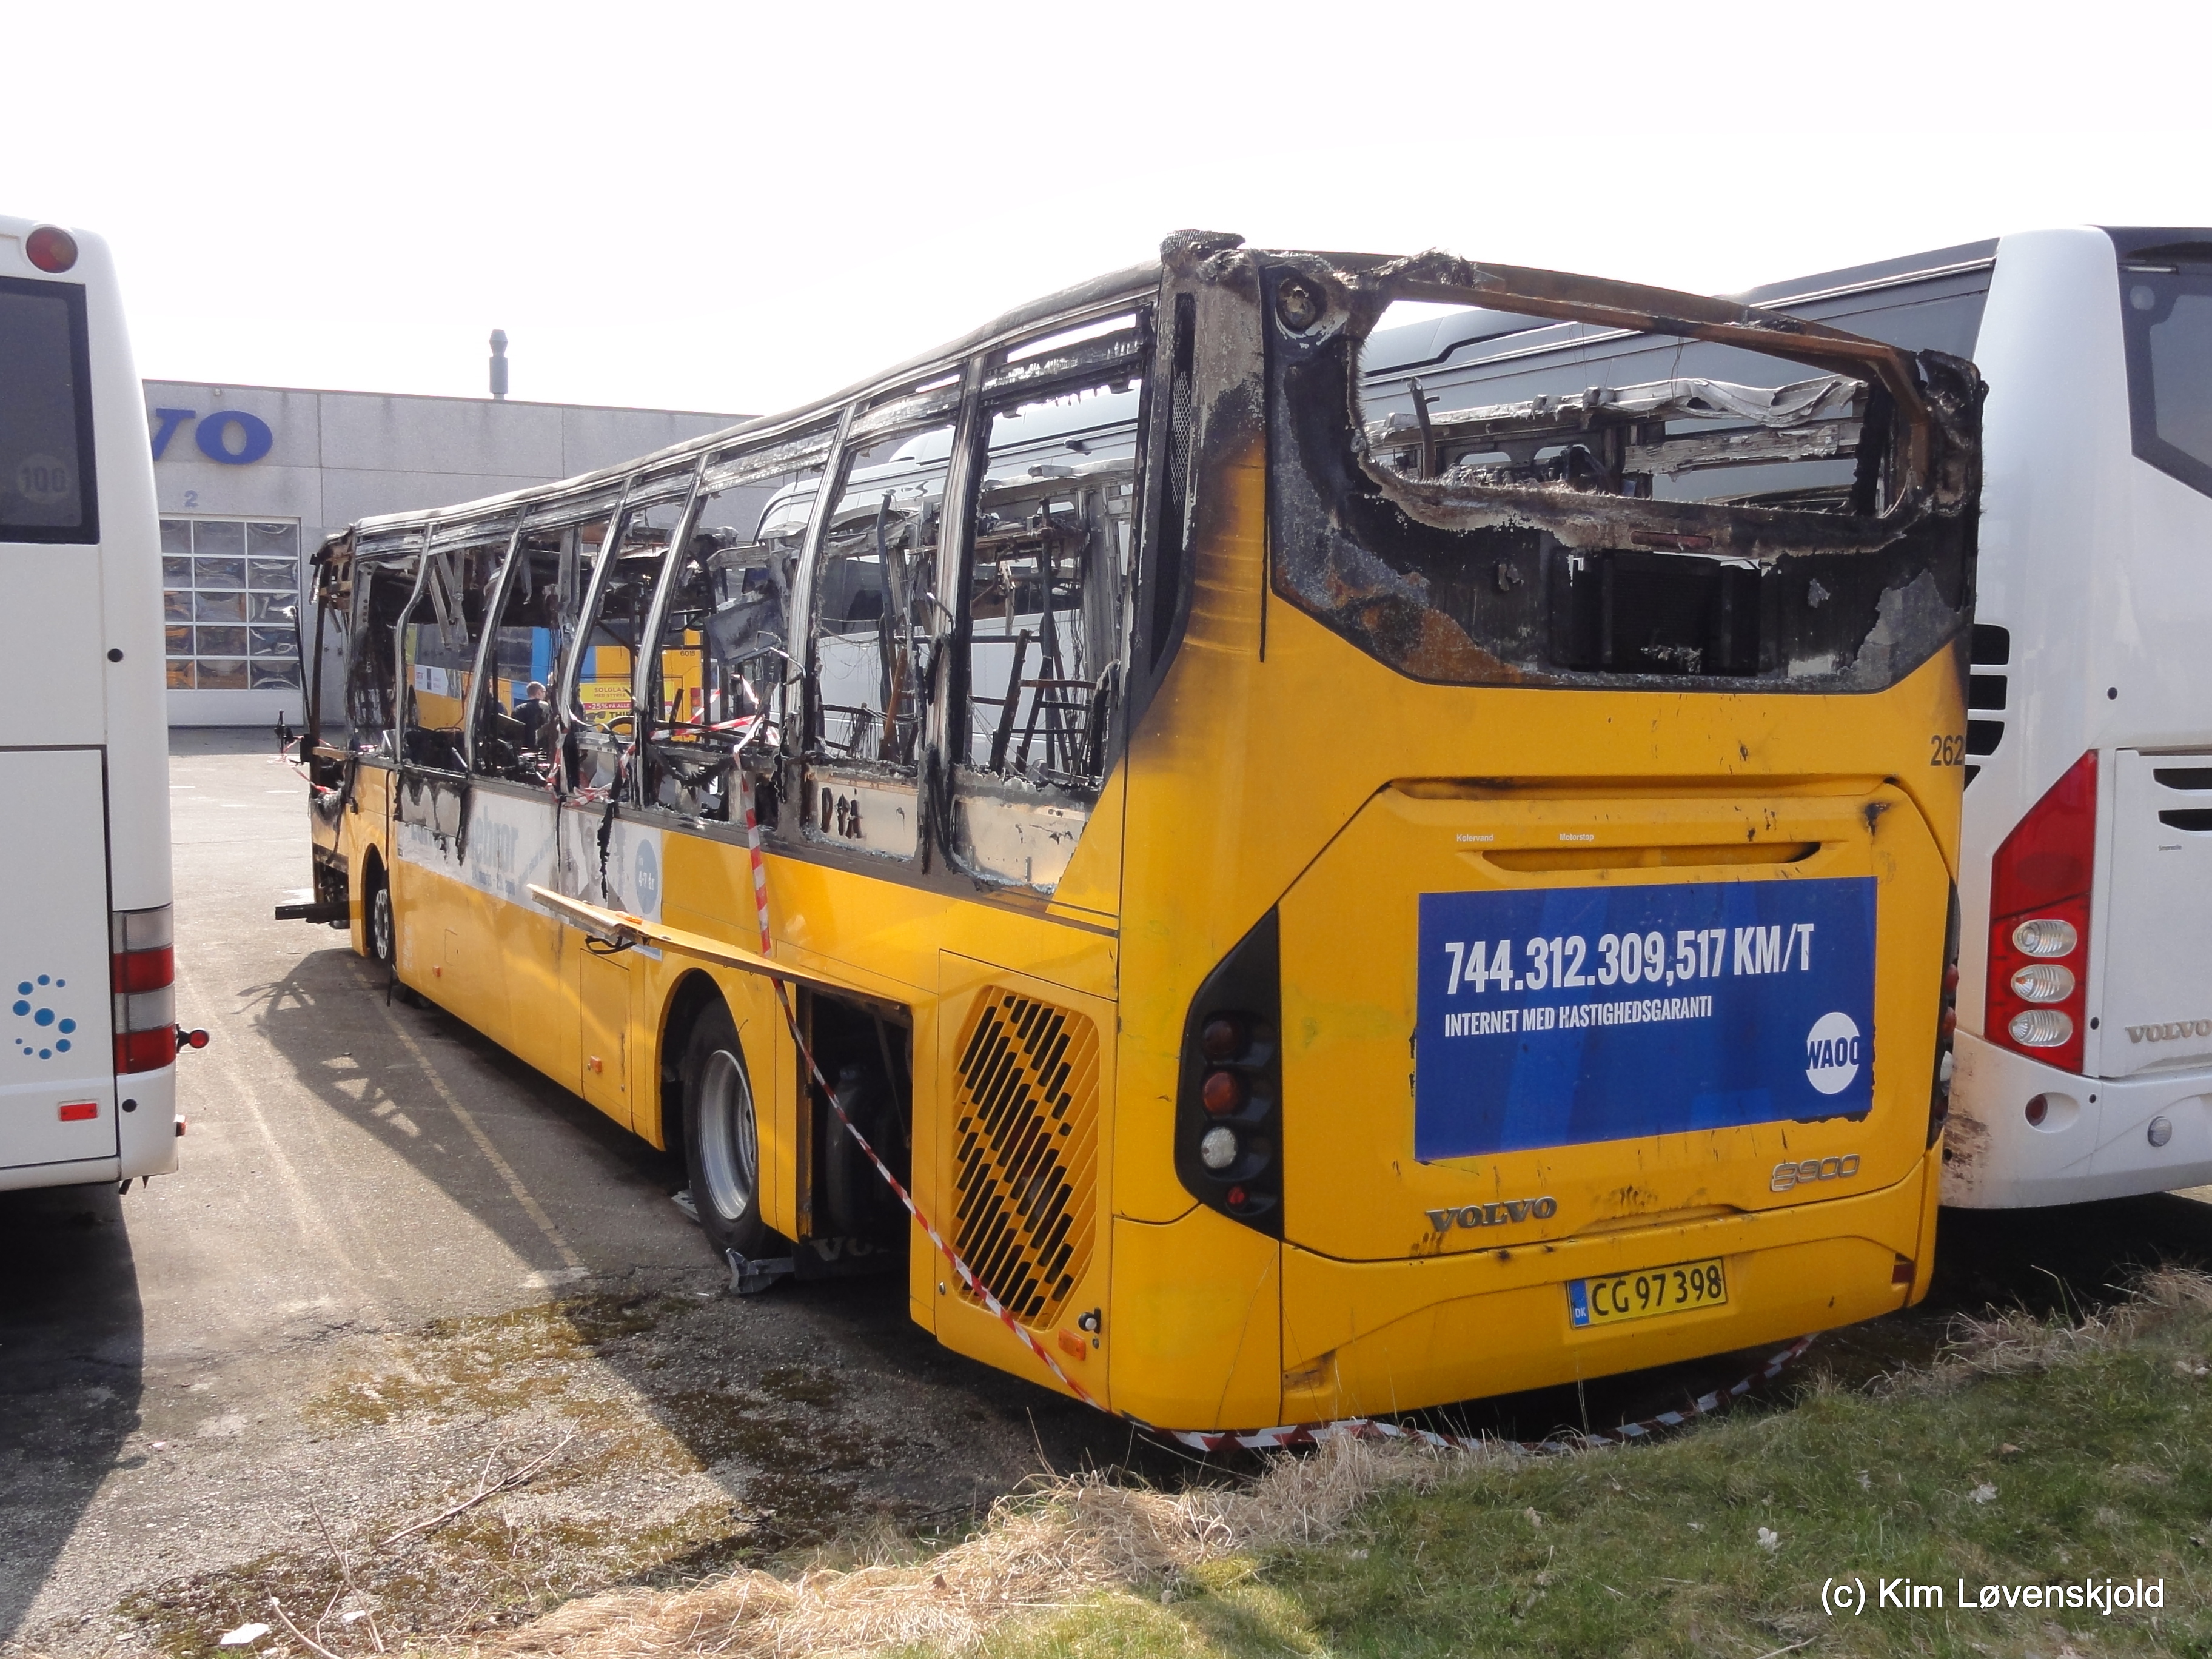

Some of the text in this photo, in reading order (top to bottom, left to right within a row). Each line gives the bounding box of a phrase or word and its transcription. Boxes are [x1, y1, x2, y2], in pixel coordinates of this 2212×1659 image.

[184, 490, 199, 507] 2
[1930, 734, 1963, 766] 262
[1559, 833, 1594, 842] Motorstop
[1445, 923, 1815, 995] 744.312.309,517 KM/T
[1444, 995, 1713, 1037] INTERNET MED HASTIGHEDSGARANTI
[2125, 1018, 2212, 1044] VOLVO
[1770, 1154, 1860, 1192] 8900
[1426, 1196, 1558, 1233] VOLVO
[1591, 1264, 1722, 1316] CG 97 398
[1575, 1307, 1587, 1318] DK
